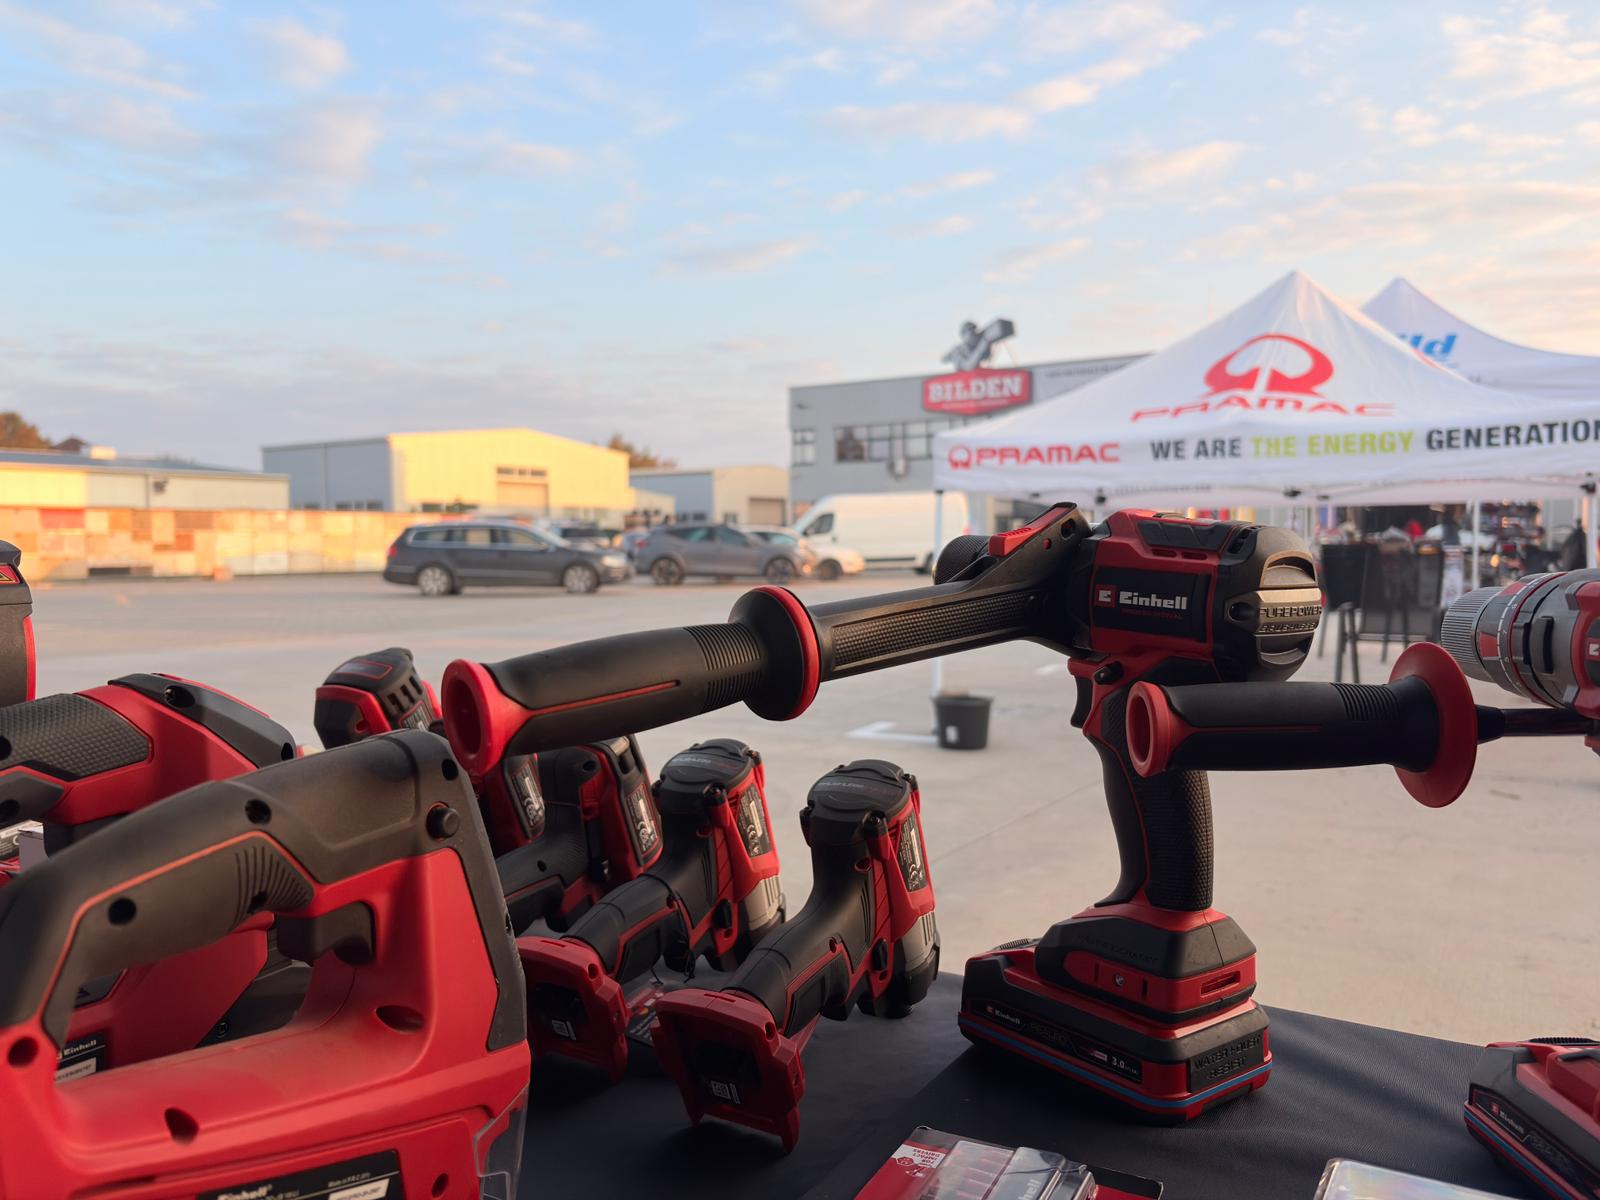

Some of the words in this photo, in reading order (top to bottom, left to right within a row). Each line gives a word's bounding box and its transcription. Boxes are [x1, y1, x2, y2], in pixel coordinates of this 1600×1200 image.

[928, 375, 1023, 402] BILDEN
[1130, 394, 1396, 422] PRAMAC
[975, 443, 1120, 466] PRAMAC
[1151, 438, 1186, 461] WE
[1193, 436, 1242, 460] ARE
[1252, 435, 1297, 458] THE
[1307, 430, 1414, 456] ENERGY
[1119, 591, 1188, 610] Einhell
[63, 1039, 97, 1056] Einhell
[1111, 1056, 1125, 1069] 3.0
